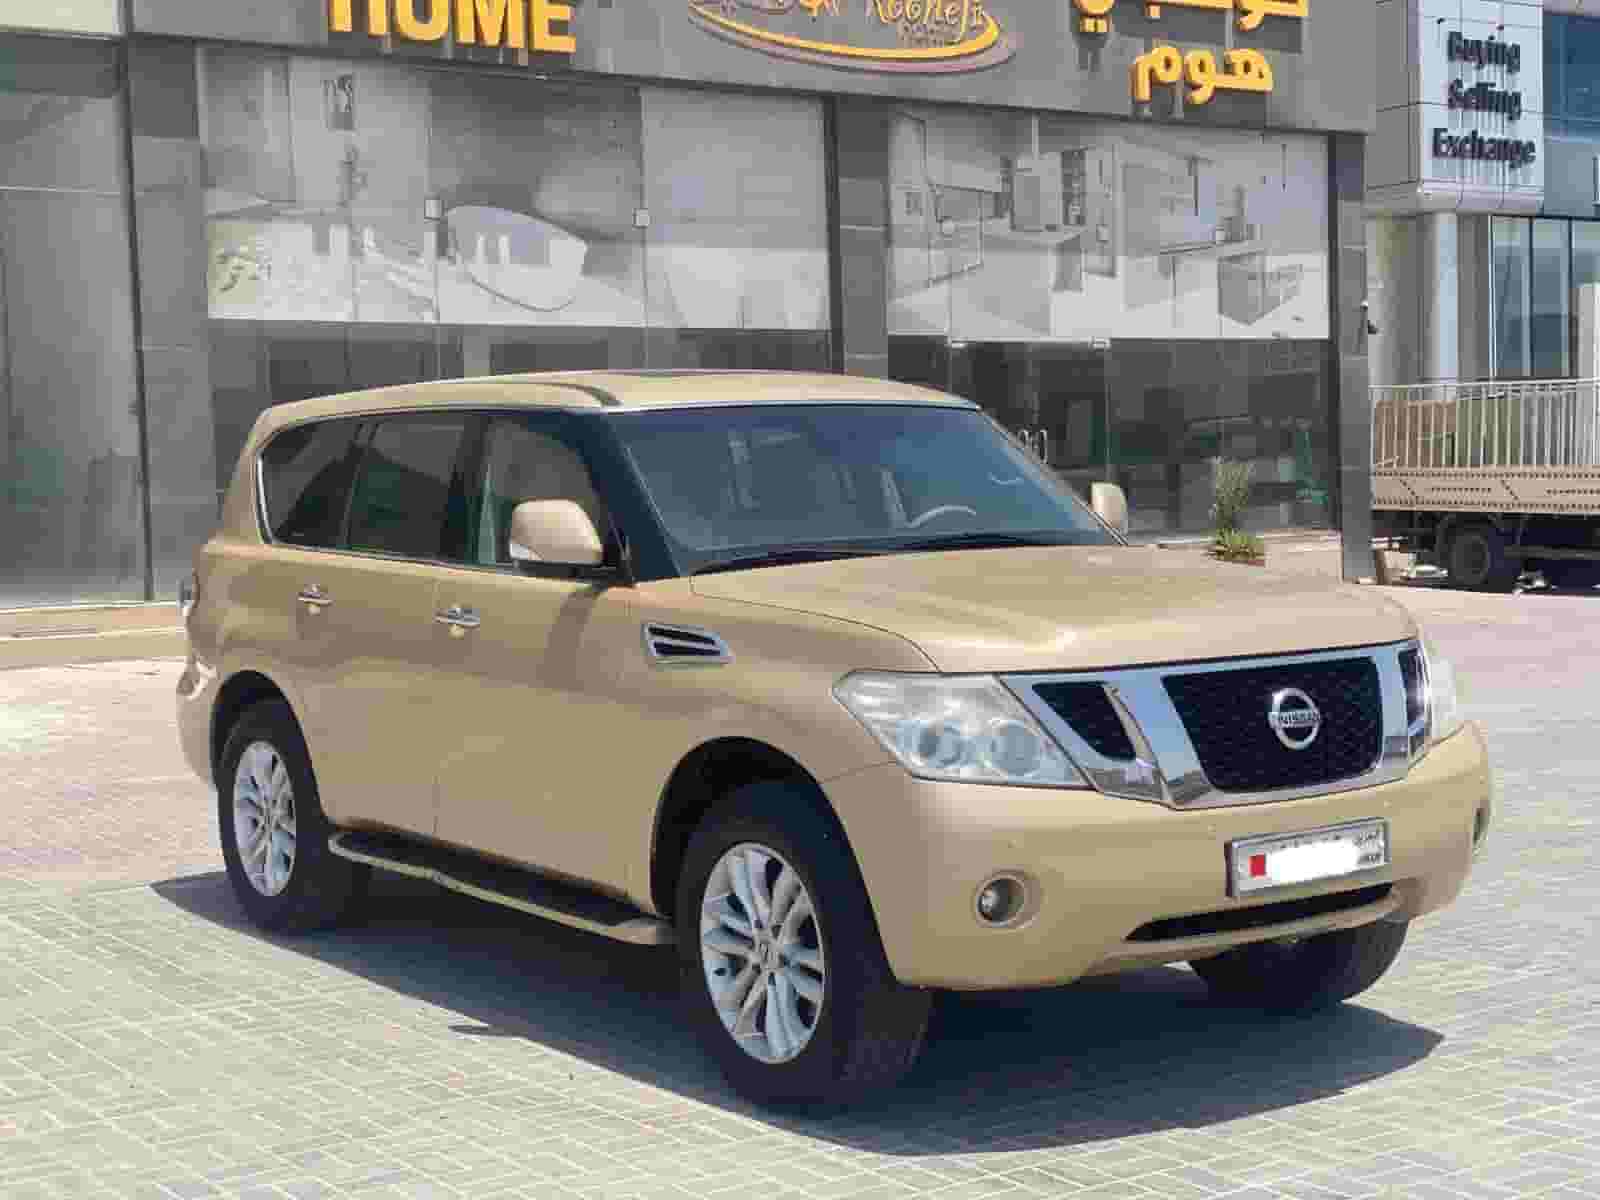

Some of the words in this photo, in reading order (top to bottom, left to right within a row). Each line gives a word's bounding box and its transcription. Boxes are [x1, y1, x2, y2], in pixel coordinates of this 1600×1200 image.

[1447, 31, 1521, 73] Buying
[1132, 46, 1274, 104] هوم
[1447, 79, 1522, 121] Selling
[1433, 127, 1536, 169] Exchange
